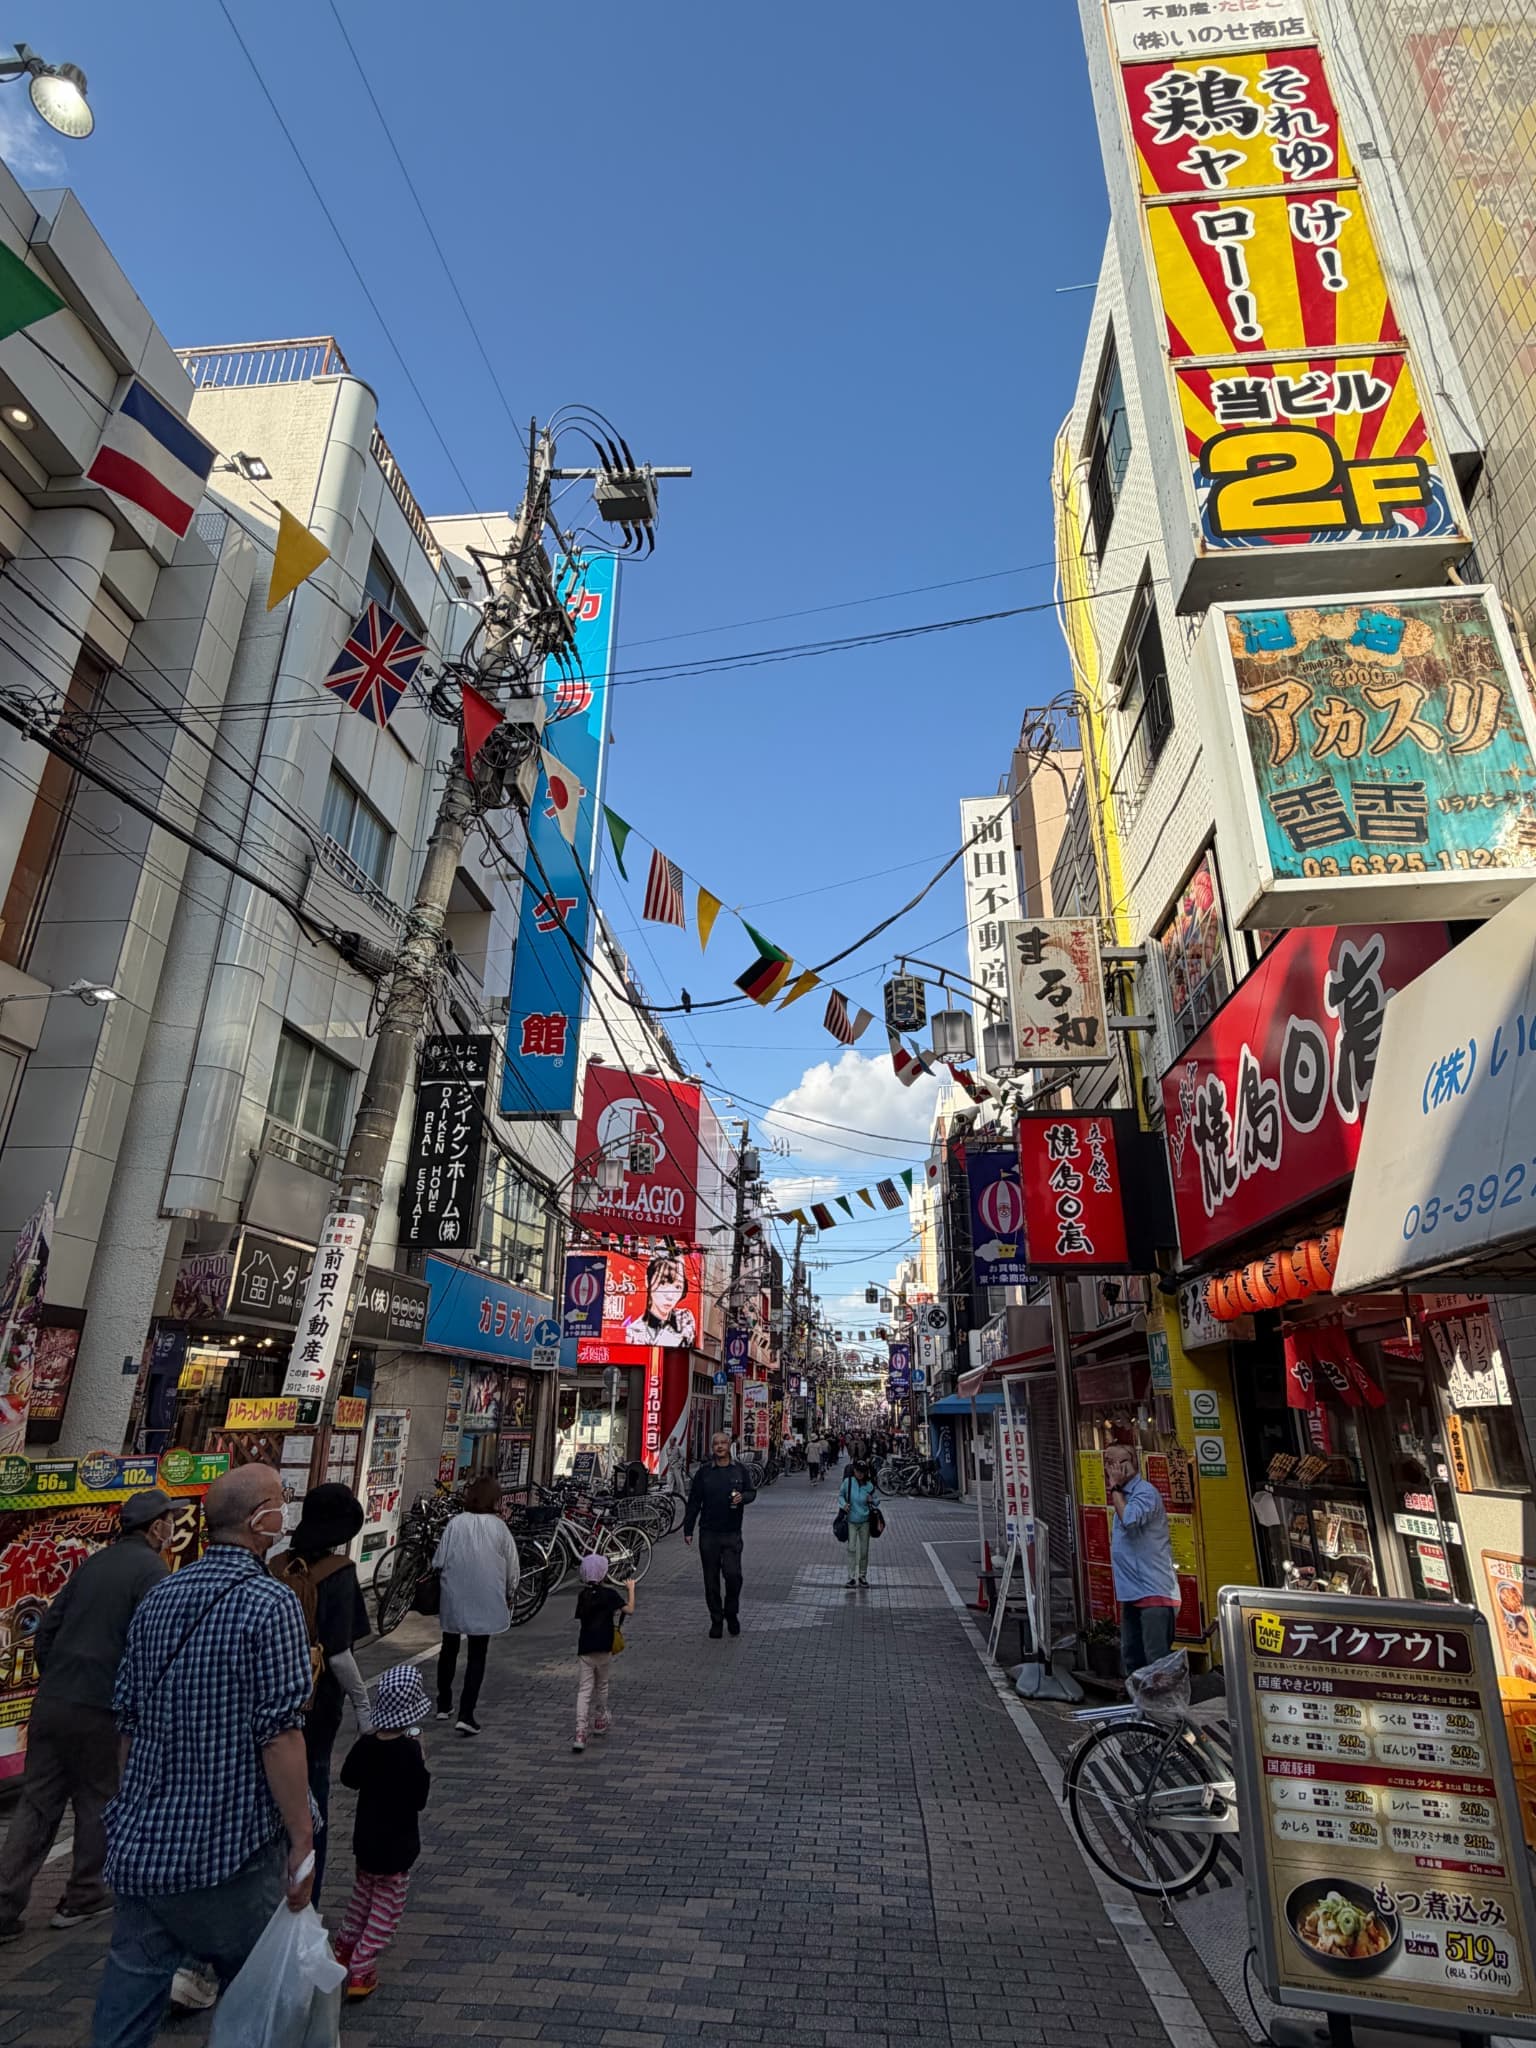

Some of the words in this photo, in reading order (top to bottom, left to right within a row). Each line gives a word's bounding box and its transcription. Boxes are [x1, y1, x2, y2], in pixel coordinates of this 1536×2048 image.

[1132, 16, 1306, 51] (株)いのせ商店
[1212, 373, 1391, 424] 当ビル
[1200, 424, 1429, 537] 2F
[1242, 676, 1505, 766] アカスリ
[1267, 774, 1429, 852] 香香
[1023, 1027, 1050, 1047] 2F
[421, 1111, 435, 1157] REAL
[434, 1087, 453, 1154] DAIKEN
[1084, 1123, 1113, 1193] 立ち飲み
[410, 1168, 427, 1239] ESTATE
[428, 1165, 442, 1213] HOME
[597, 1182, 685, 1217] ELLAGIO
[299, 1248, 345, 1364] 前田不動産
[479, 1296, 546, 1344] カラオケ
[1472, 1322, 1488, 1371] カシラ
[1258, 1626, 1281, 1640] TAKE
[1259, 1637, 1279, 1650] OUT
[1289, 1624, 1457, 1668] テイクアウト
[1258, 1675, 1333, 1693] 国産やきとり串
[1272, 1733, 1300, 1746] ねぎま
[1379, 1714, 1406, 1726] つくね
[1267, 1759, 1316, 1777] 国産豚串
[1281, 1820, 1310, 1833] かしら
[1392, 1800, 1419, 1811] レバー
[1373, 1881, 1505, 1926] もつ煮込み
[1446, 1931, 1508, 1969] 519円
